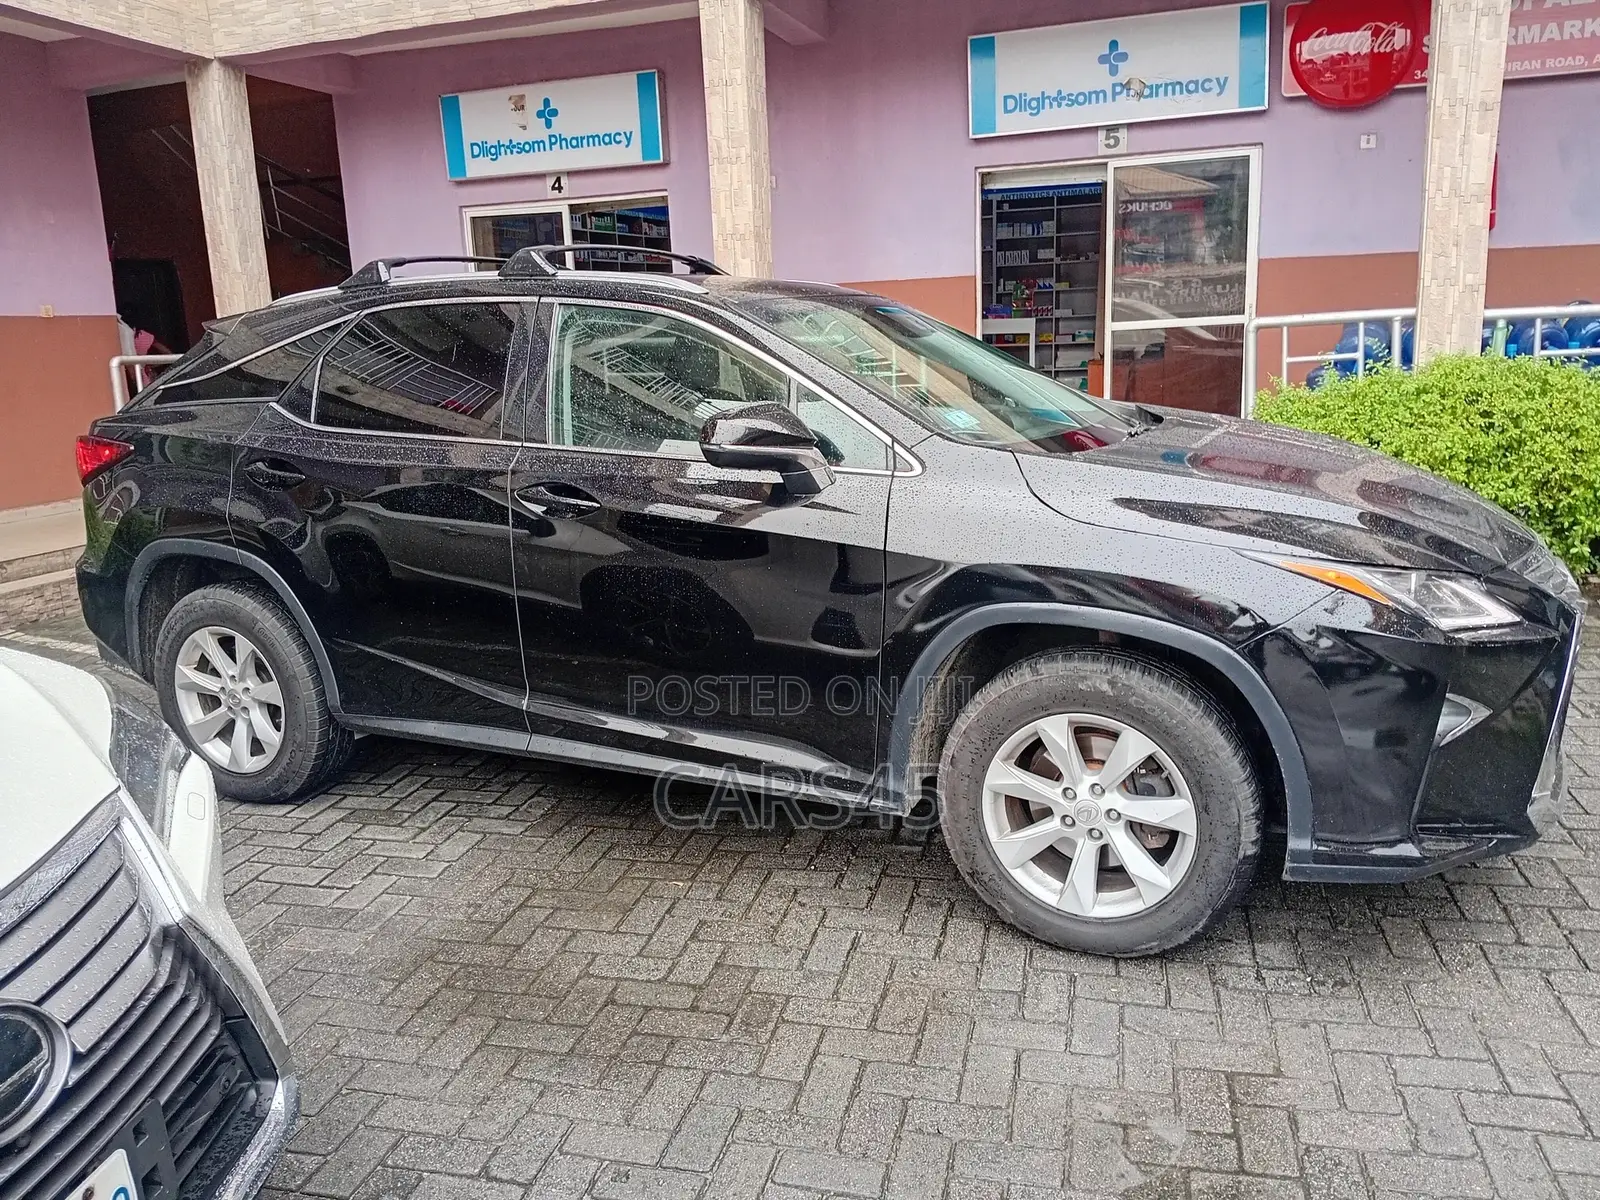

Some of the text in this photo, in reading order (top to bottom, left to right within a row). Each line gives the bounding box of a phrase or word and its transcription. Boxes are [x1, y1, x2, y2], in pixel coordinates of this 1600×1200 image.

[1504, 59, 1541, 71] IRAN
[1545, 55, 1588, 68] ROAD,
[548, 130, 633, 152] Pharmacy
[1104, 128, 1120, 150] 5
[551, 176, 564, 194] 4
[1000, 190, 1050, 201] ANTIBIOTICS
